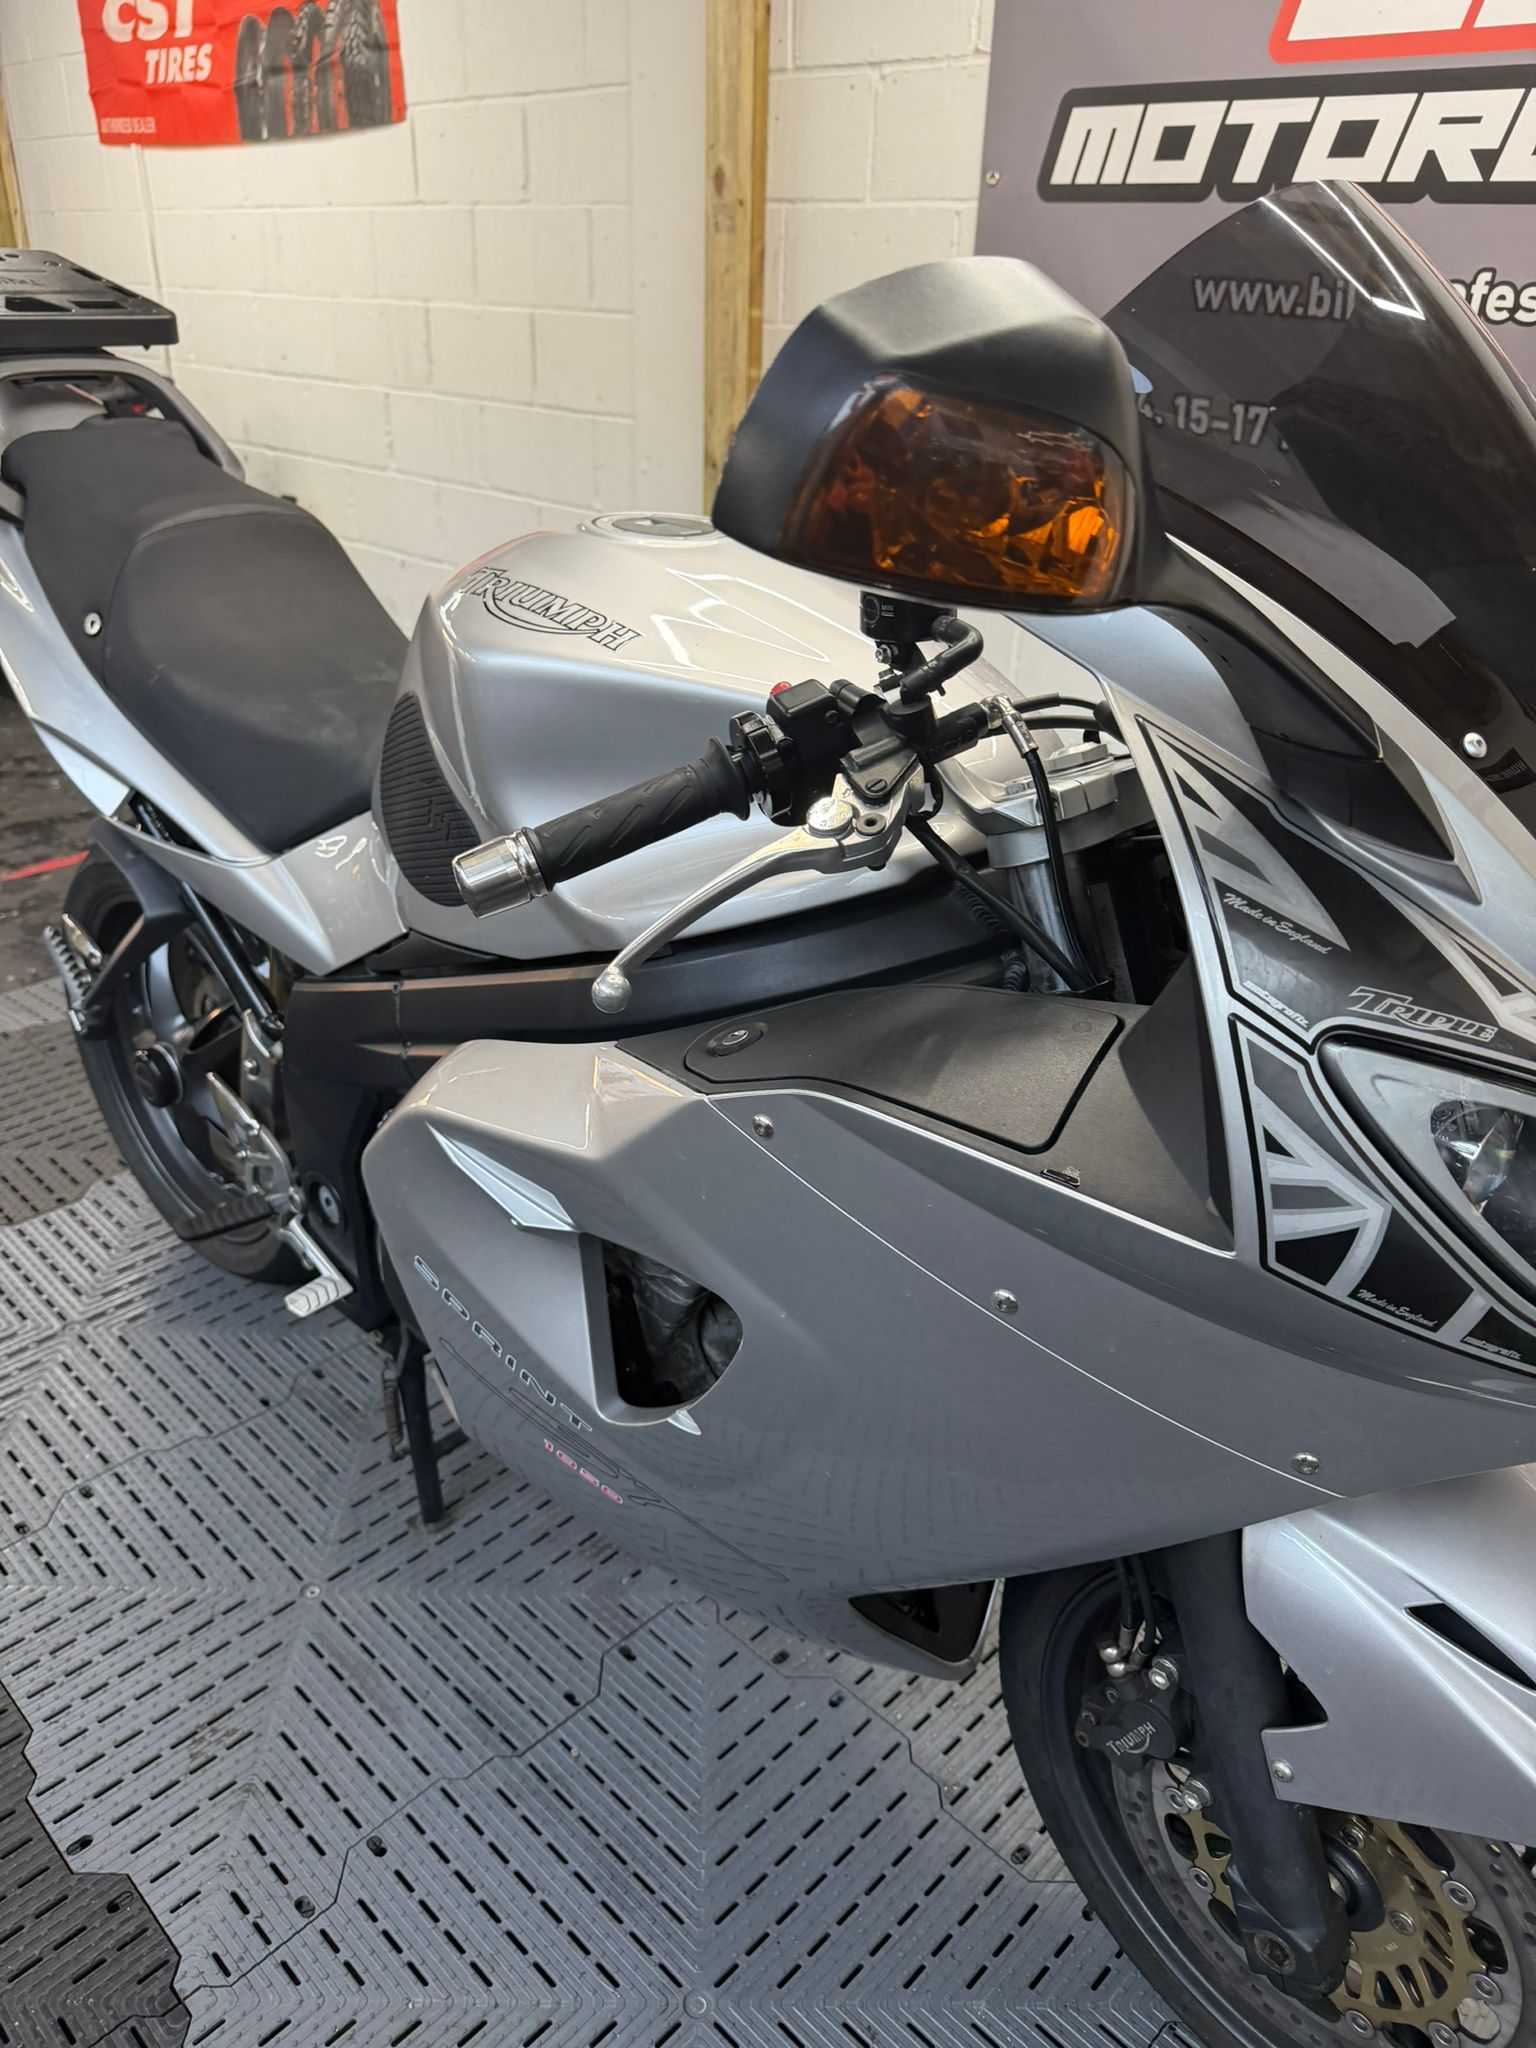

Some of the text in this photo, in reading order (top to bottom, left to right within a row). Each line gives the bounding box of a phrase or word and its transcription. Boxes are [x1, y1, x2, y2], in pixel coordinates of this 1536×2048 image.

[102, 0, 194, 43] CST
[145, 43, 213, 85] TIRES
[460, 566, 643, 652] TRIUMPH
[1223, 893, 1332, 954] Made in England
[1347, 985, 1498, 1043] TRIPLE
[1357, 1289, 1438, 1328] Made in England
[414, 1255, 593, 1432] SPRINT
[544, 1439, 623, 1505] 1050
[1106, 1721, 1156, 1756] TRIUMPH
